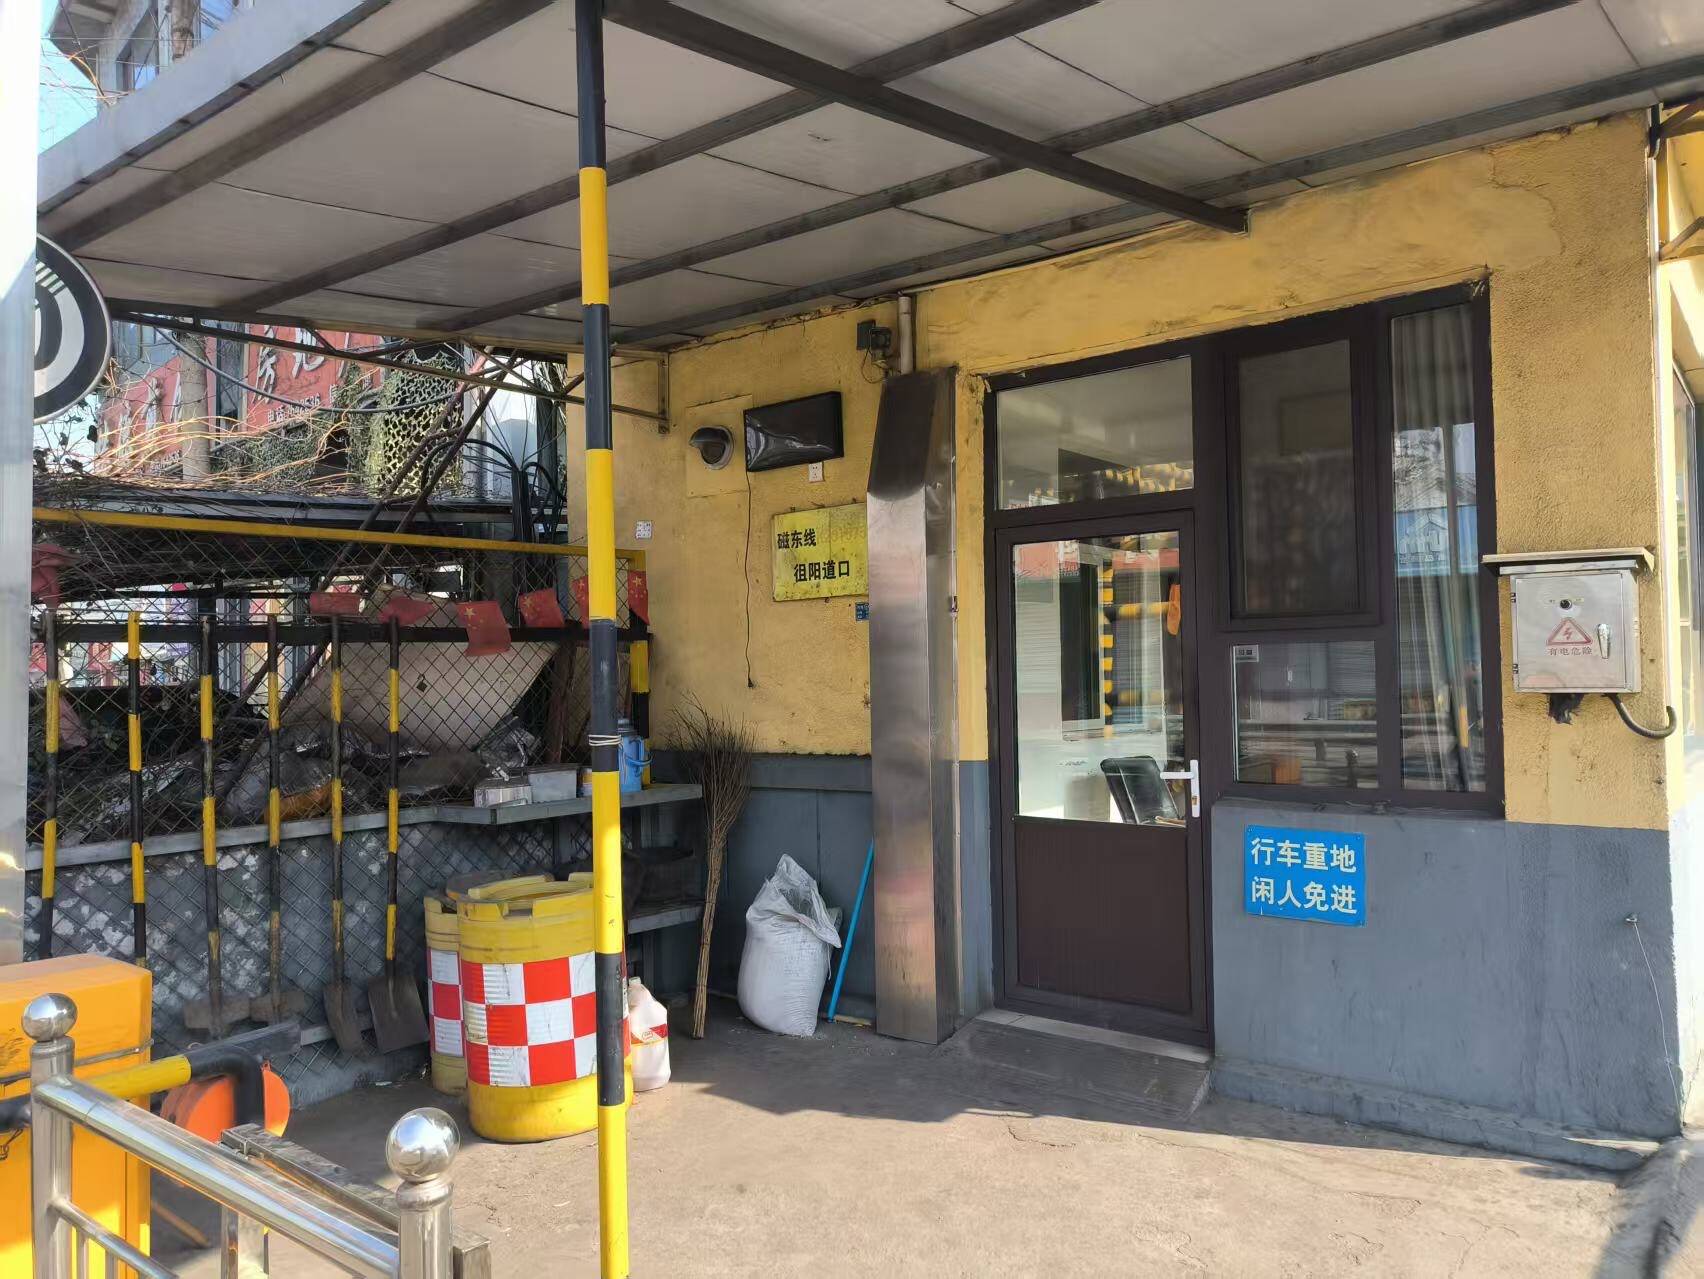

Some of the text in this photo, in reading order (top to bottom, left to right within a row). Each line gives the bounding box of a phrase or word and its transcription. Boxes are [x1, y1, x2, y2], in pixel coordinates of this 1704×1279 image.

[777, 528, 817, 550] 磁东线
[1547, 646, 1593, 656] 有电危险
[1251, 837, 1357, 873] 行车重地
[1251, 876, 1357, 914] 闲人免进
